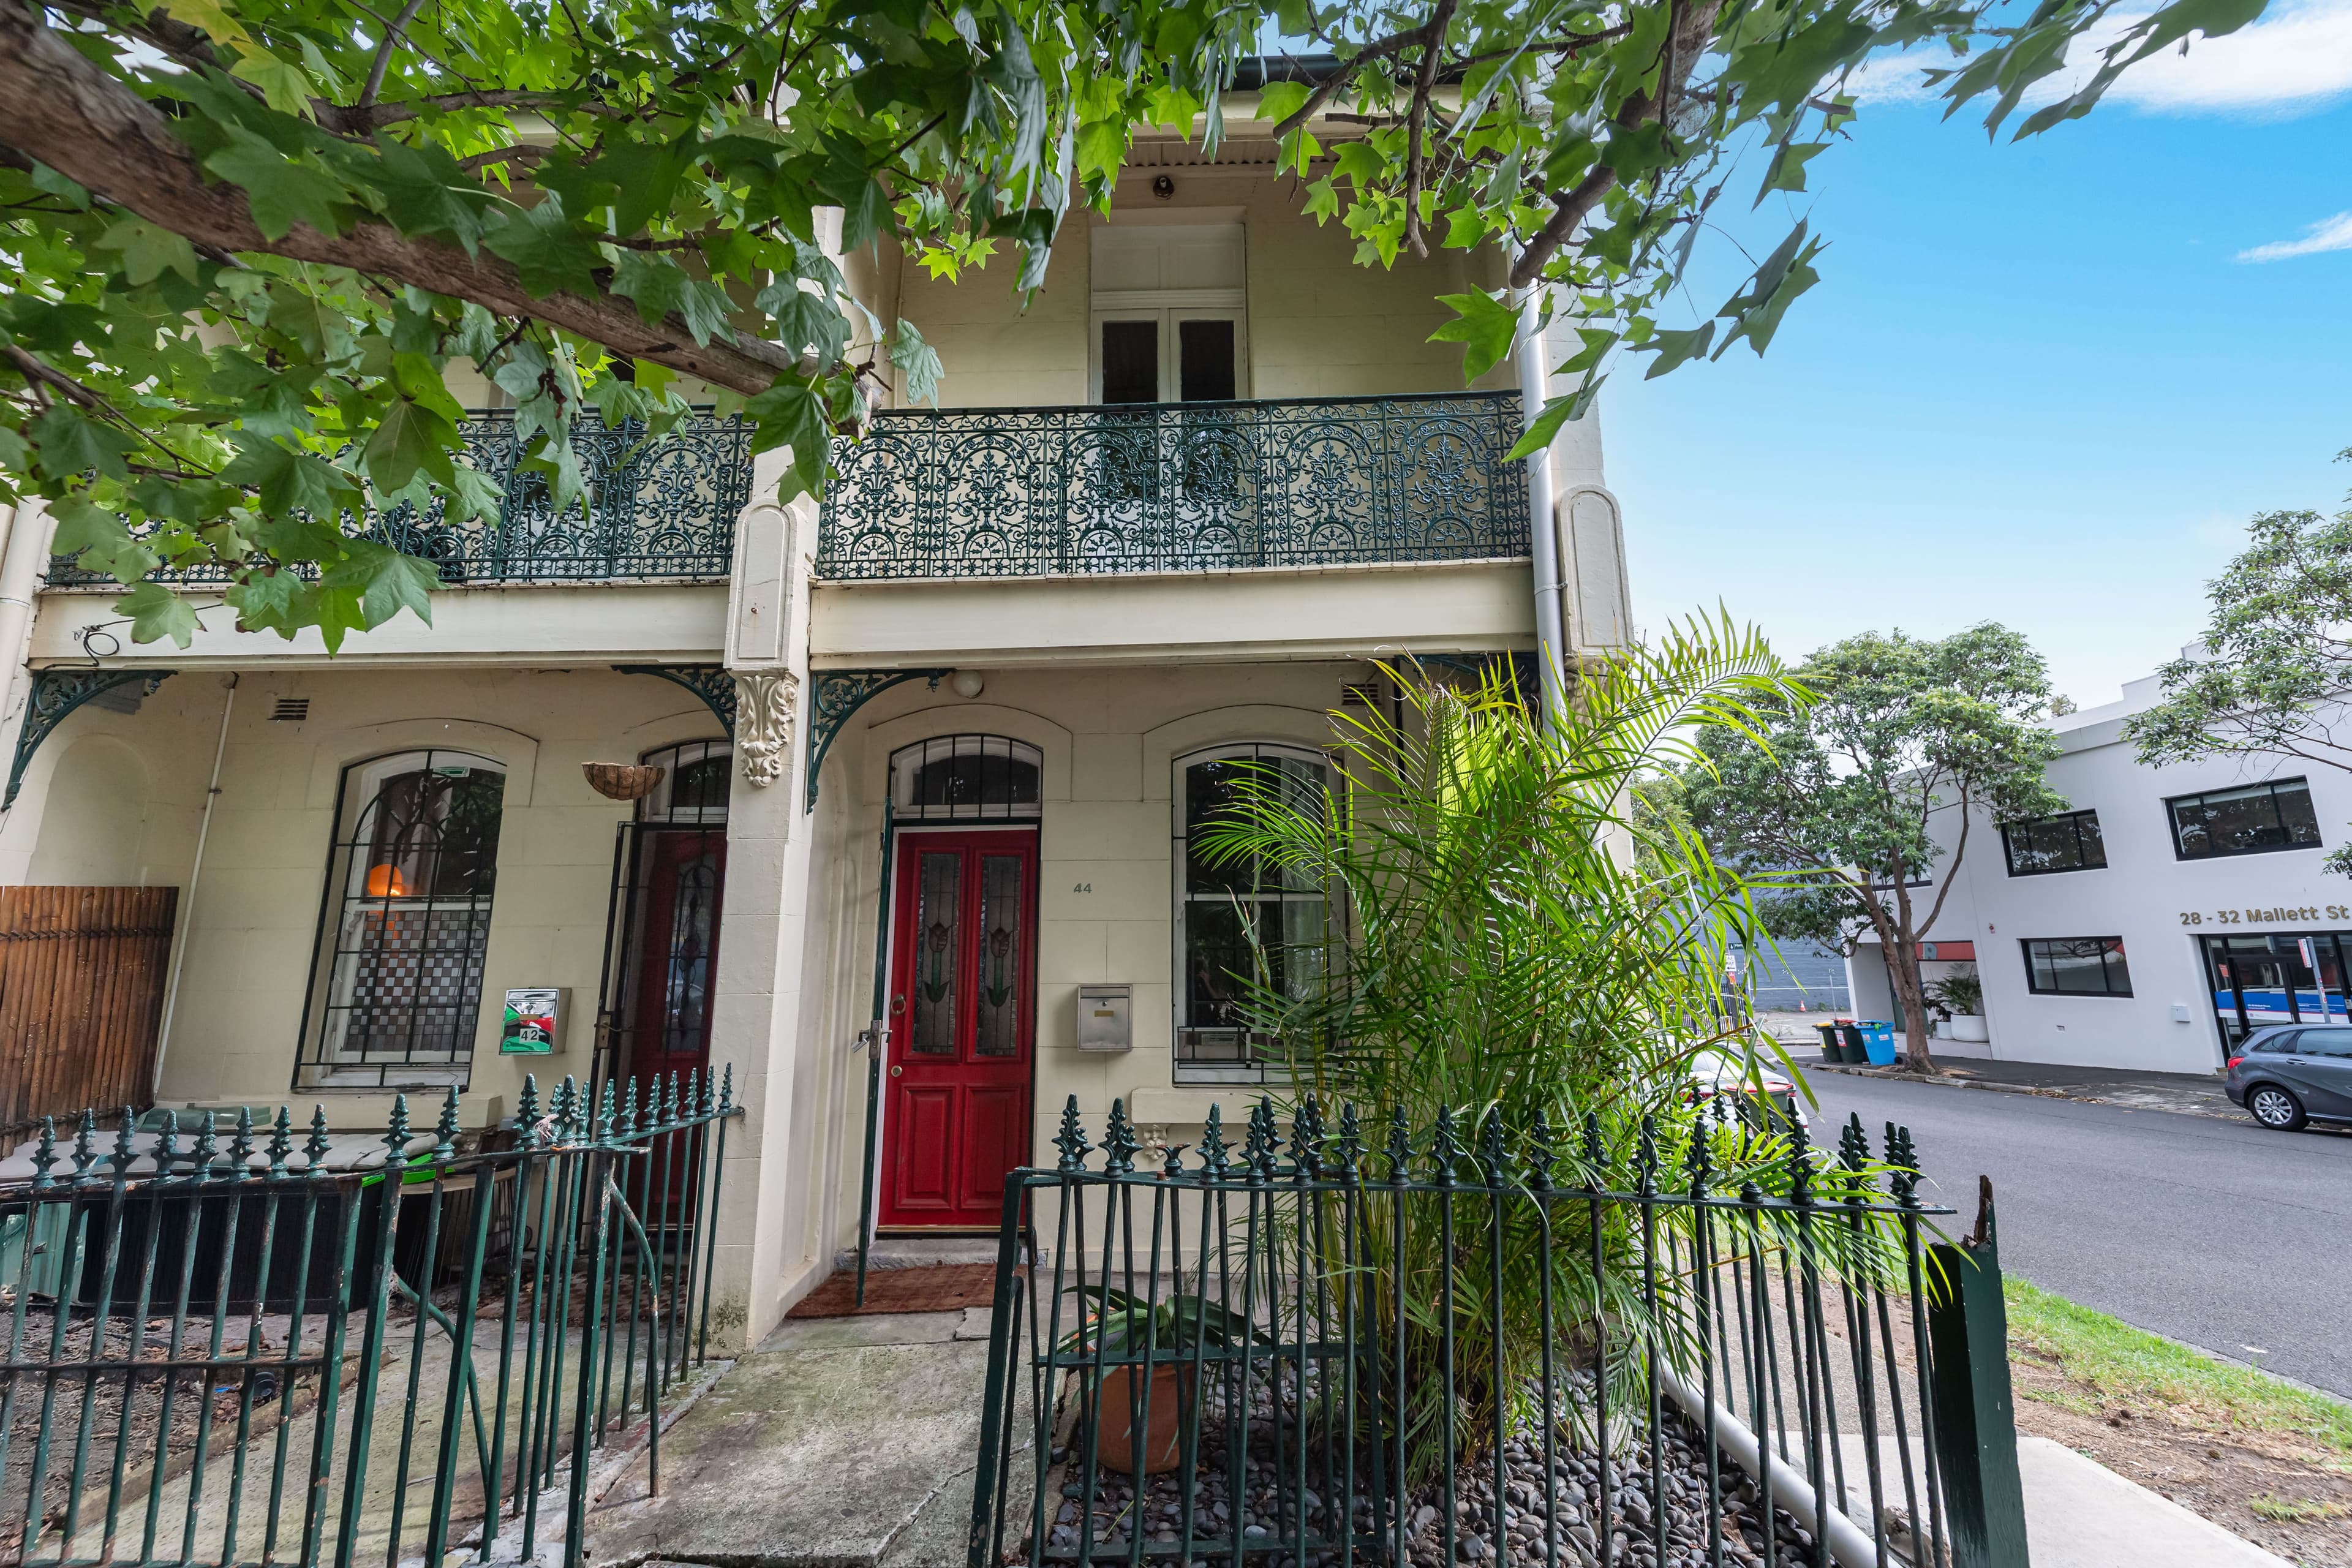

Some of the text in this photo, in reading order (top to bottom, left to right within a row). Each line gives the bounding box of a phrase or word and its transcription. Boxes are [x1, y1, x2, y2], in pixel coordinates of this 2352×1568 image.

[1073, 883, 1092, 893] 44
[2179, 912, 2202, 925] 28
[2217, 910, 2241, 924] 32
[2245, 906, 2319, 922] Mallett
[2326, 905, 2350, 919] St
[521, 1030, 538, 1041] 42
